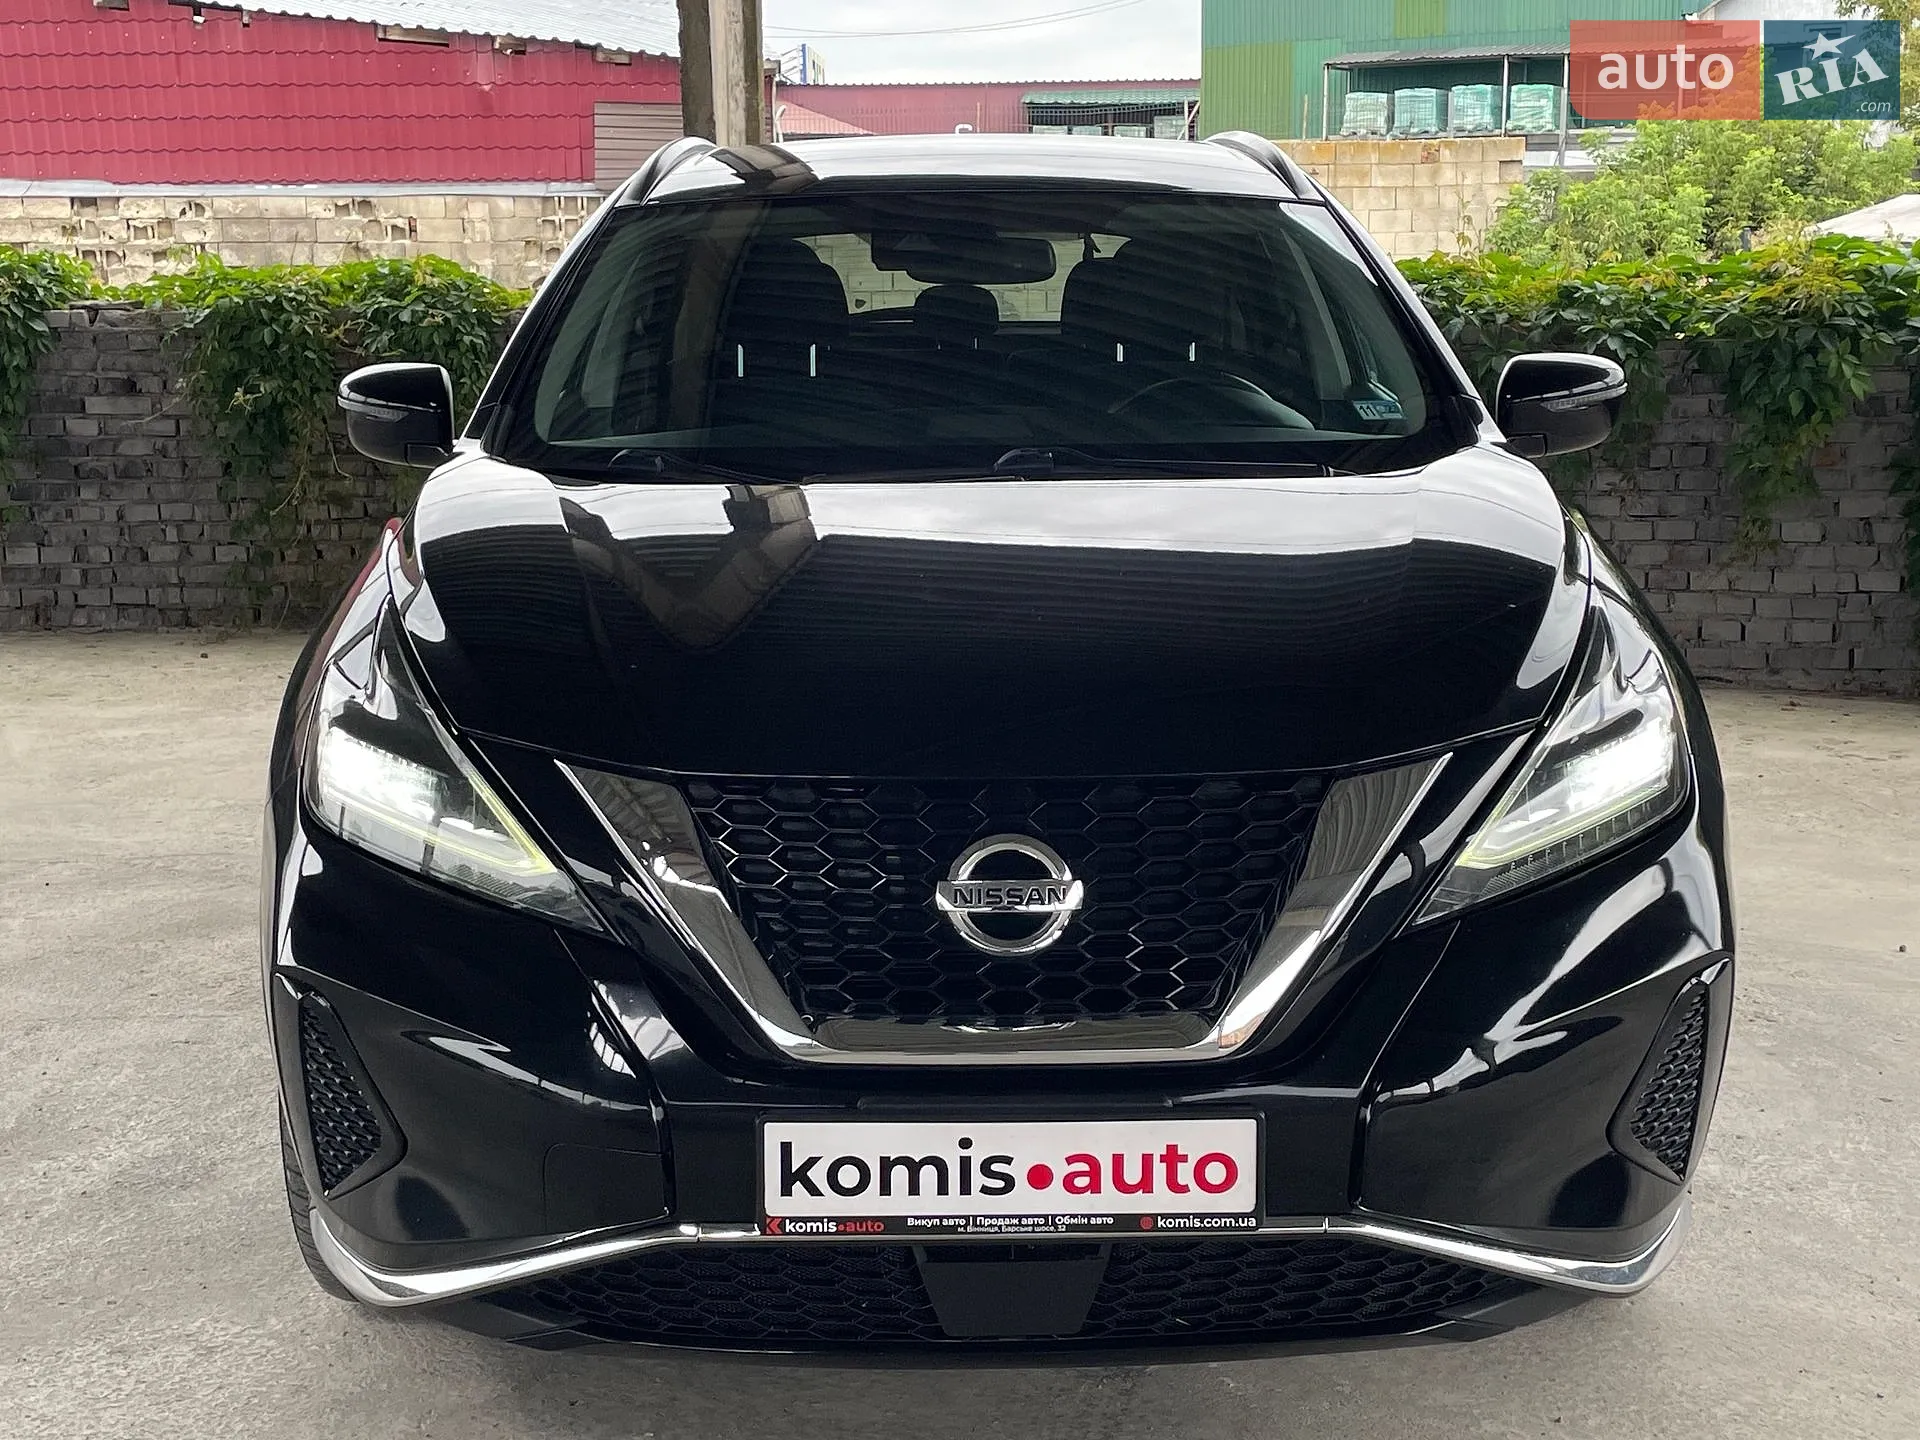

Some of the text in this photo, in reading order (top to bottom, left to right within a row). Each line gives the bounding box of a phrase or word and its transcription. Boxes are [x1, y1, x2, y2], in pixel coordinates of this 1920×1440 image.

[953, 886, 1067, 906] NISSAN
[907, 1215, 1114, 1227] Викуп авто Продаж авто Обмін авто
[1157, 1215, 1257, 1229] komis.com.ua
